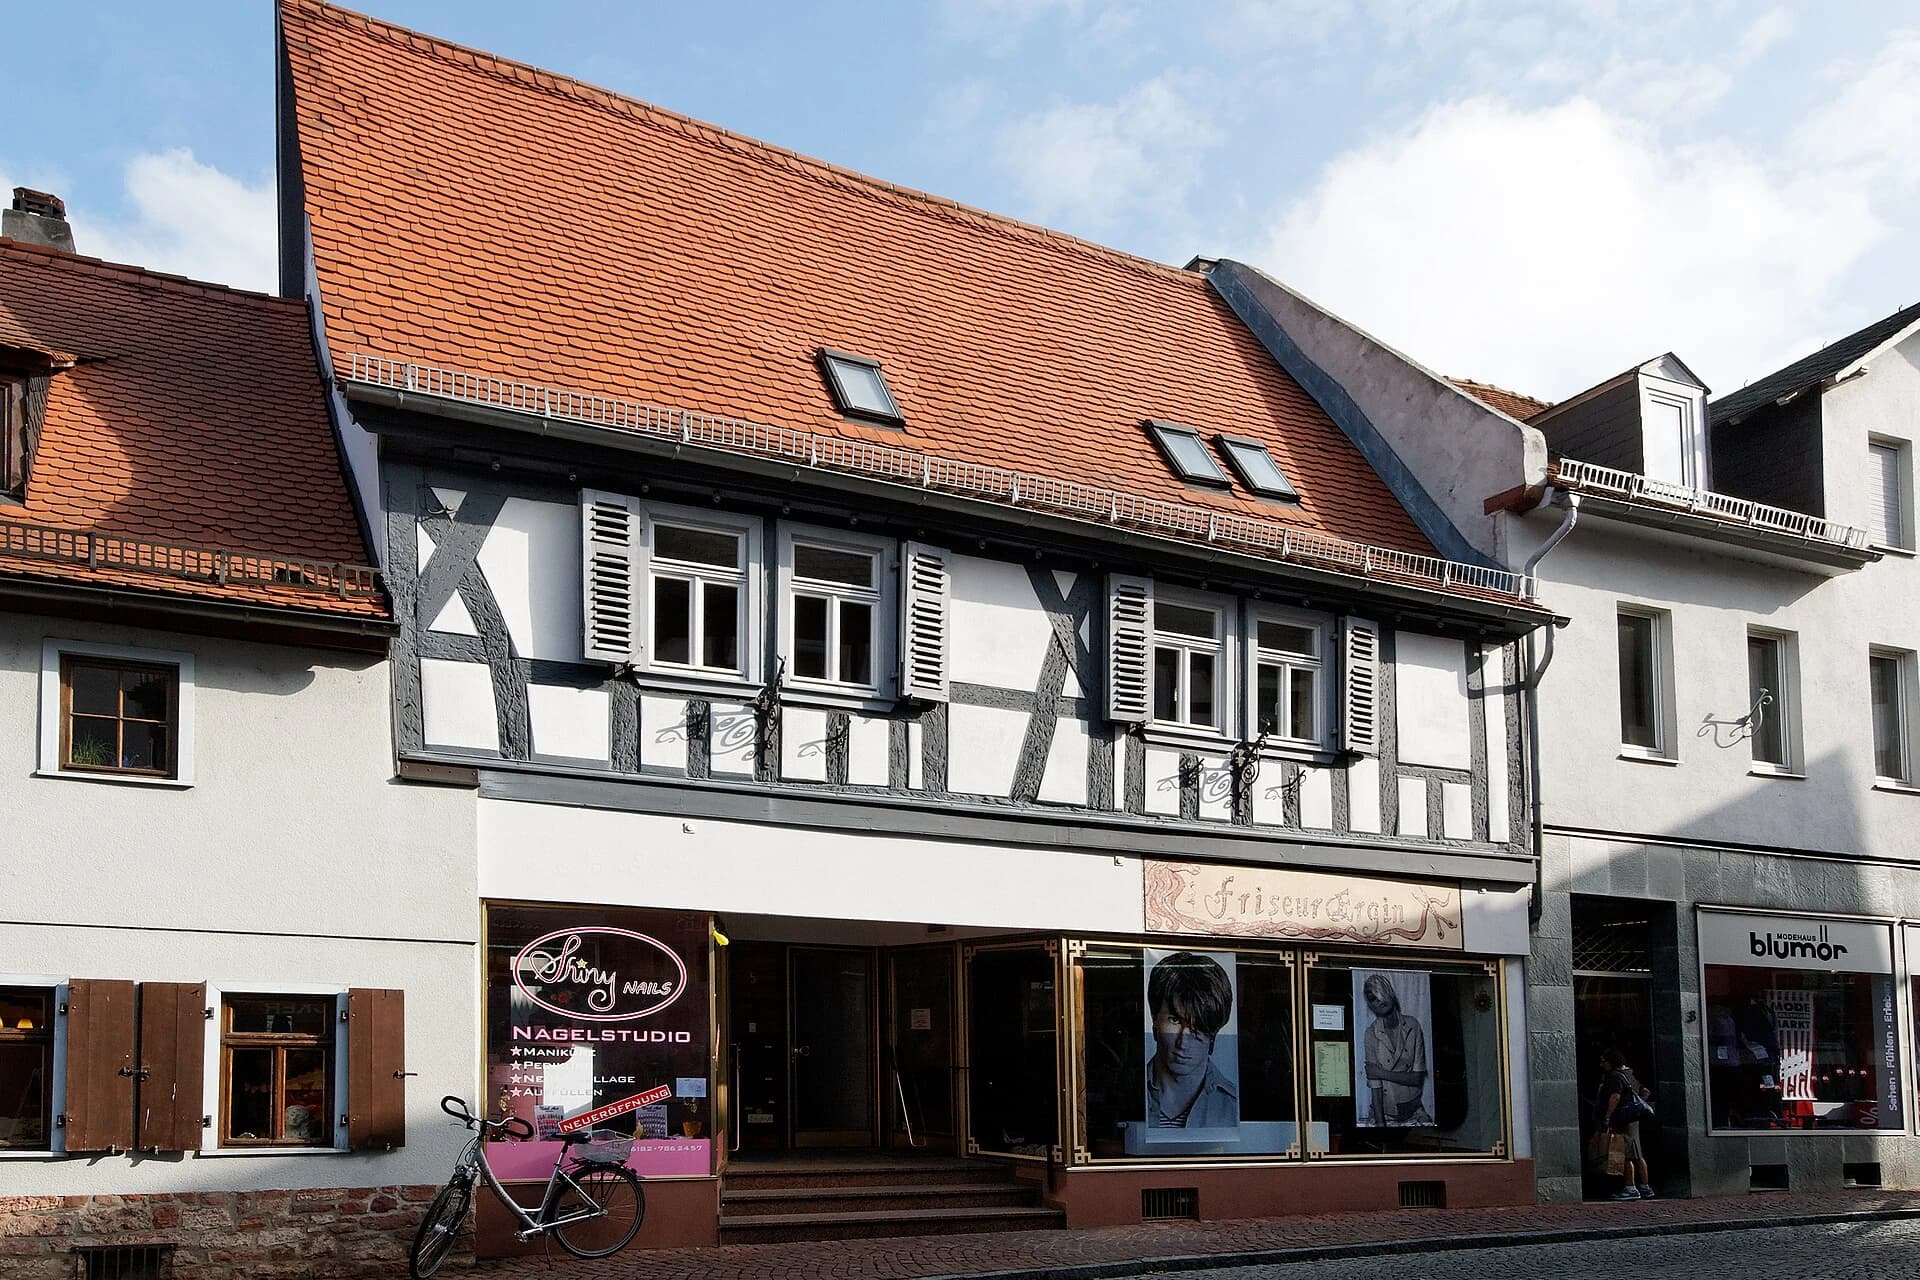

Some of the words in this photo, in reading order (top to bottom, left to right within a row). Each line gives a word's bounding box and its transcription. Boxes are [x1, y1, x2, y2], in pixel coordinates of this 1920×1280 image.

[1203, 875, 1324, 919] Friseur
[1776, 933, 1817, 942] MODEHAUS
[528, 934, 617, 1012] Shiny
[622, 980, 673, 996] NAILS
[512, 1025, 691, 1043] NAGELSTUDIO
[1885, 1031, 1896, 1069] Fühlen
[523, 1047, 597, 1057] MANIKÜE
[522, 1088, 603, 1097] AUÜLLEN
[563, 1088, 670, 1131] NEUERÖFFNUNG
[1889, 1077, 1898, 1112] Sehen
